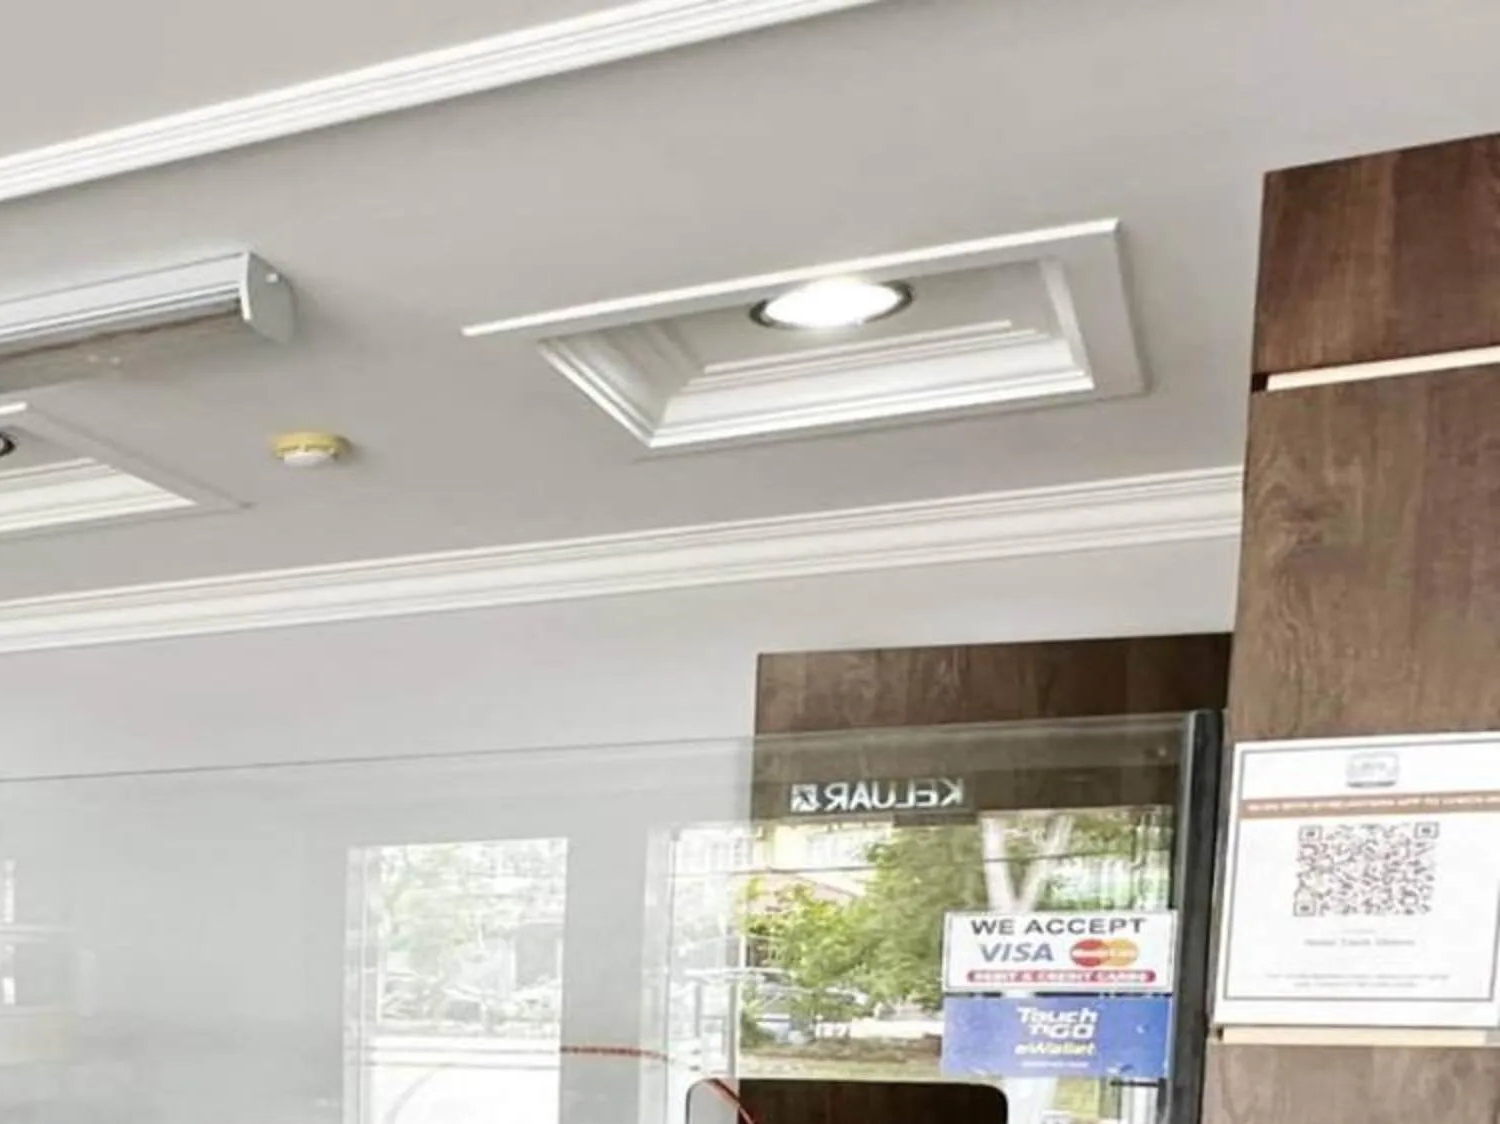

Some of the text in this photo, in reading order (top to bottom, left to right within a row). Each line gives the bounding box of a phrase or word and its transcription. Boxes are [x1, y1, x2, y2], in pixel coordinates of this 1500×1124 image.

[970, 917, 1147, 935] WE ACCEPT
[978, 942, 1055, 962] VISA
[1016, 1006, 1098, 1024] Touch
